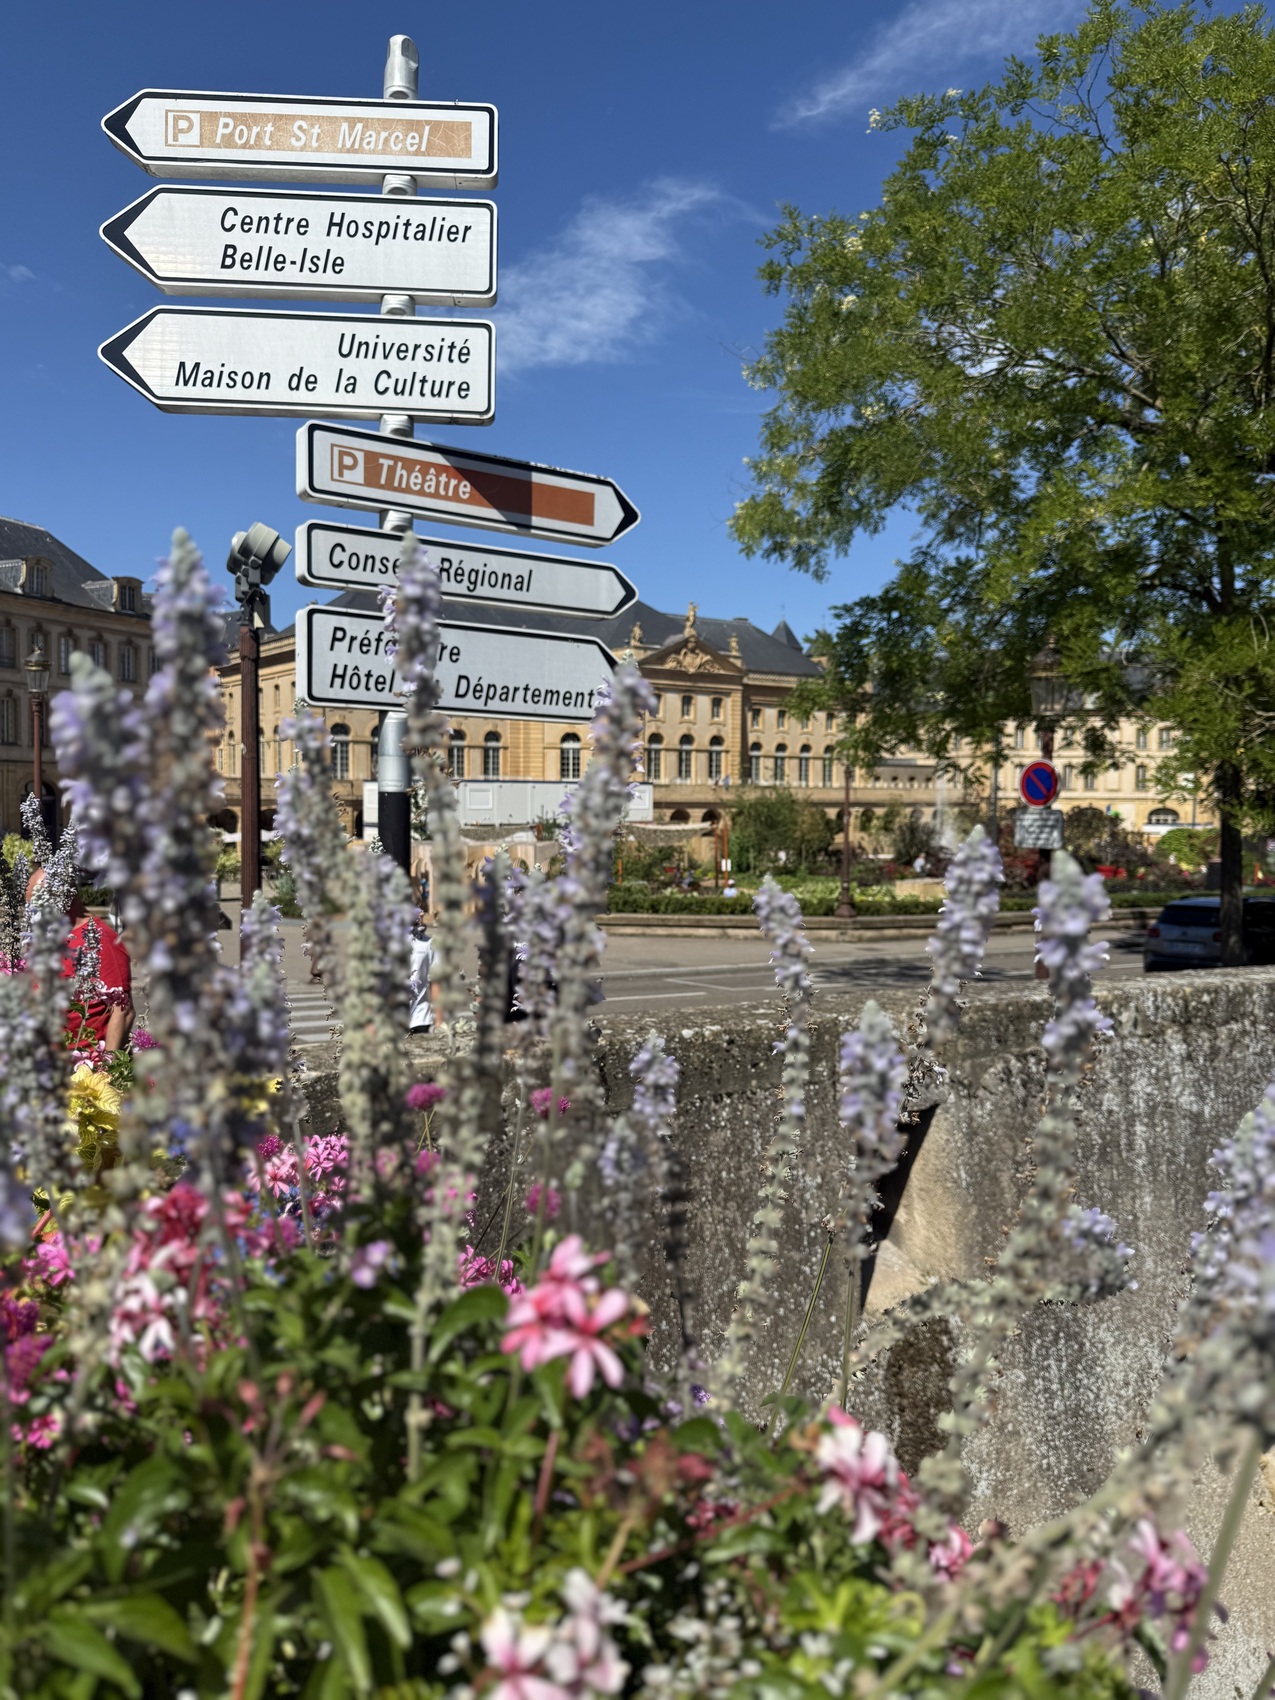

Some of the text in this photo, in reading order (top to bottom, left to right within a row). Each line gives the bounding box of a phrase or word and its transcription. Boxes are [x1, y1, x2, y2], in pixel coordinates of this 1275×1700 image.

[172, 114, 430, 152] P Port St Marcel
[220, 206, 472, 246] Centre Hospitalier
[220, 243, 345, 275] Belle-Isle
[338, 332, 471, 364] Université
[174, 361, 470, 400] Maison de la Culture
[338, 449, 472, 500] P Théâtre
[329, 542, 533, 594] Conse Régional
[329, 626, 461, 664] Préfre
[329, 663, 595, 709] Hôtel Département
